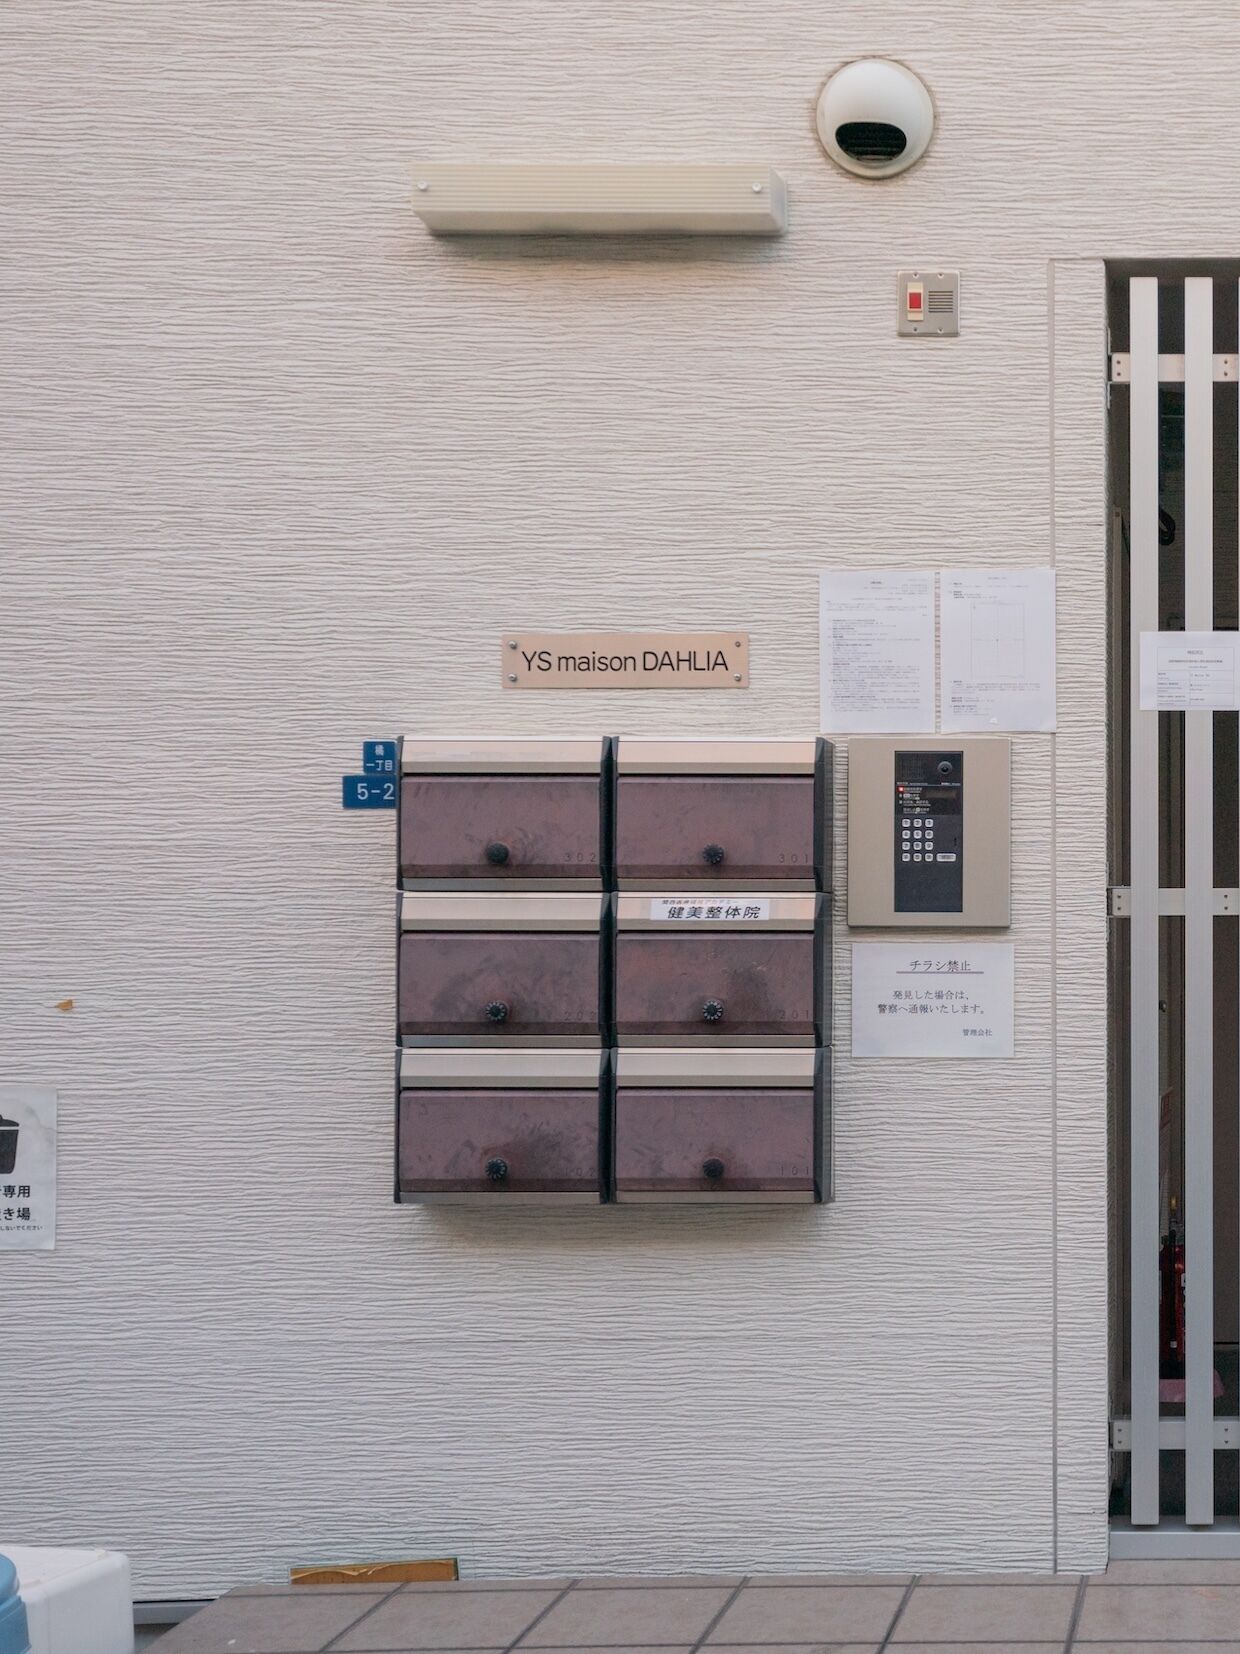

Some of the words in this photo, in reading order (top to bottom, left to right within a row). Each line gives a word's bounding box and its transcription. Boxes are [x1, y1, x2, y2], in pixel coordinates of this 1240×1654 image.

[521, 650, 552, 672] YS
[557, 650, 636, 672] maison
[643, 650, 729, 672] DAHLIA
[366, 759, 393, 771] 一丁目
[357, 783, 395, 800] 5-2
[778, 853, 809, 864] 301
[667, 906, 761, 919] 健美整体院
[909, 959, 972, 972] チラシ禁止
[892, 990, 969, 1001] 発見した場合は、
[877, 1003, 985, 1015] 警察へ通報いたします。
[962, 1028, 993, 1037] 管理会社
[0, 1185, 31, 1199] 専用
[0, 1207, 31, 1221] き場
